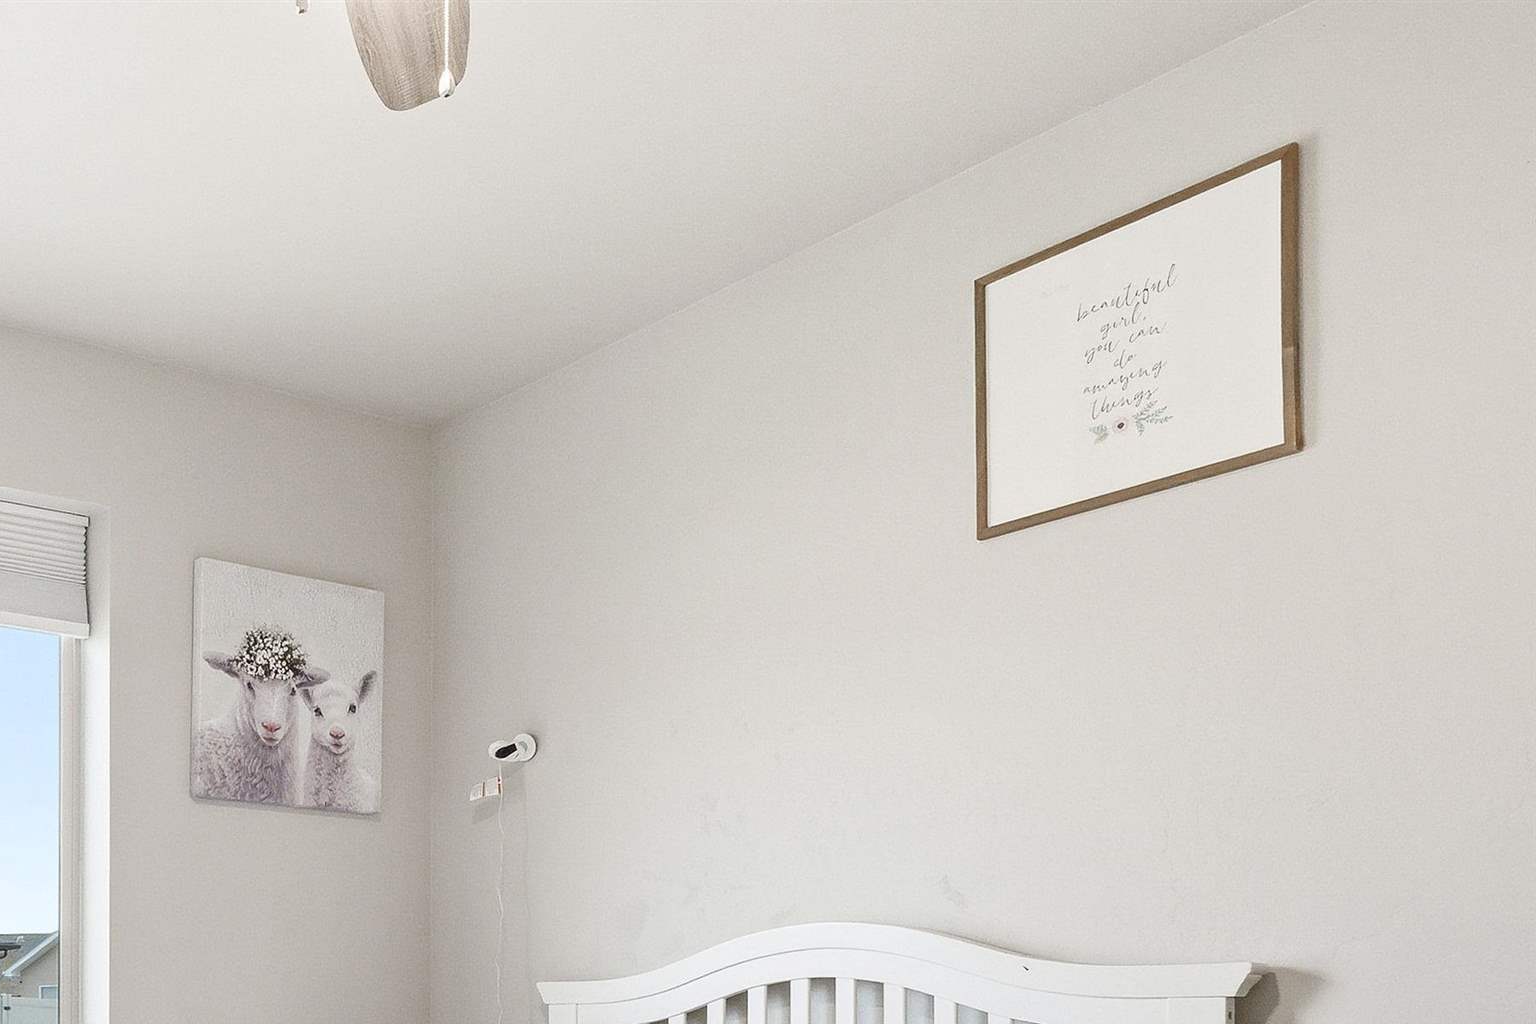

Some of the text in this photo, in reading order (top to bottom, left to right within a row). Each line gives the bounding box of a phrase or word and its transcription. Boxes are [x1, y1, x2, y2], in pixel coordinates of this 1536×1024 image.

[1076, 263, 1177, 322] beautiful
[1084, 322, 1167, 364] you can
[1114, 349, 1137, 369] do
[1083, 360, 1167, 391] amazing
[1091, 387, 1158, 420] things
